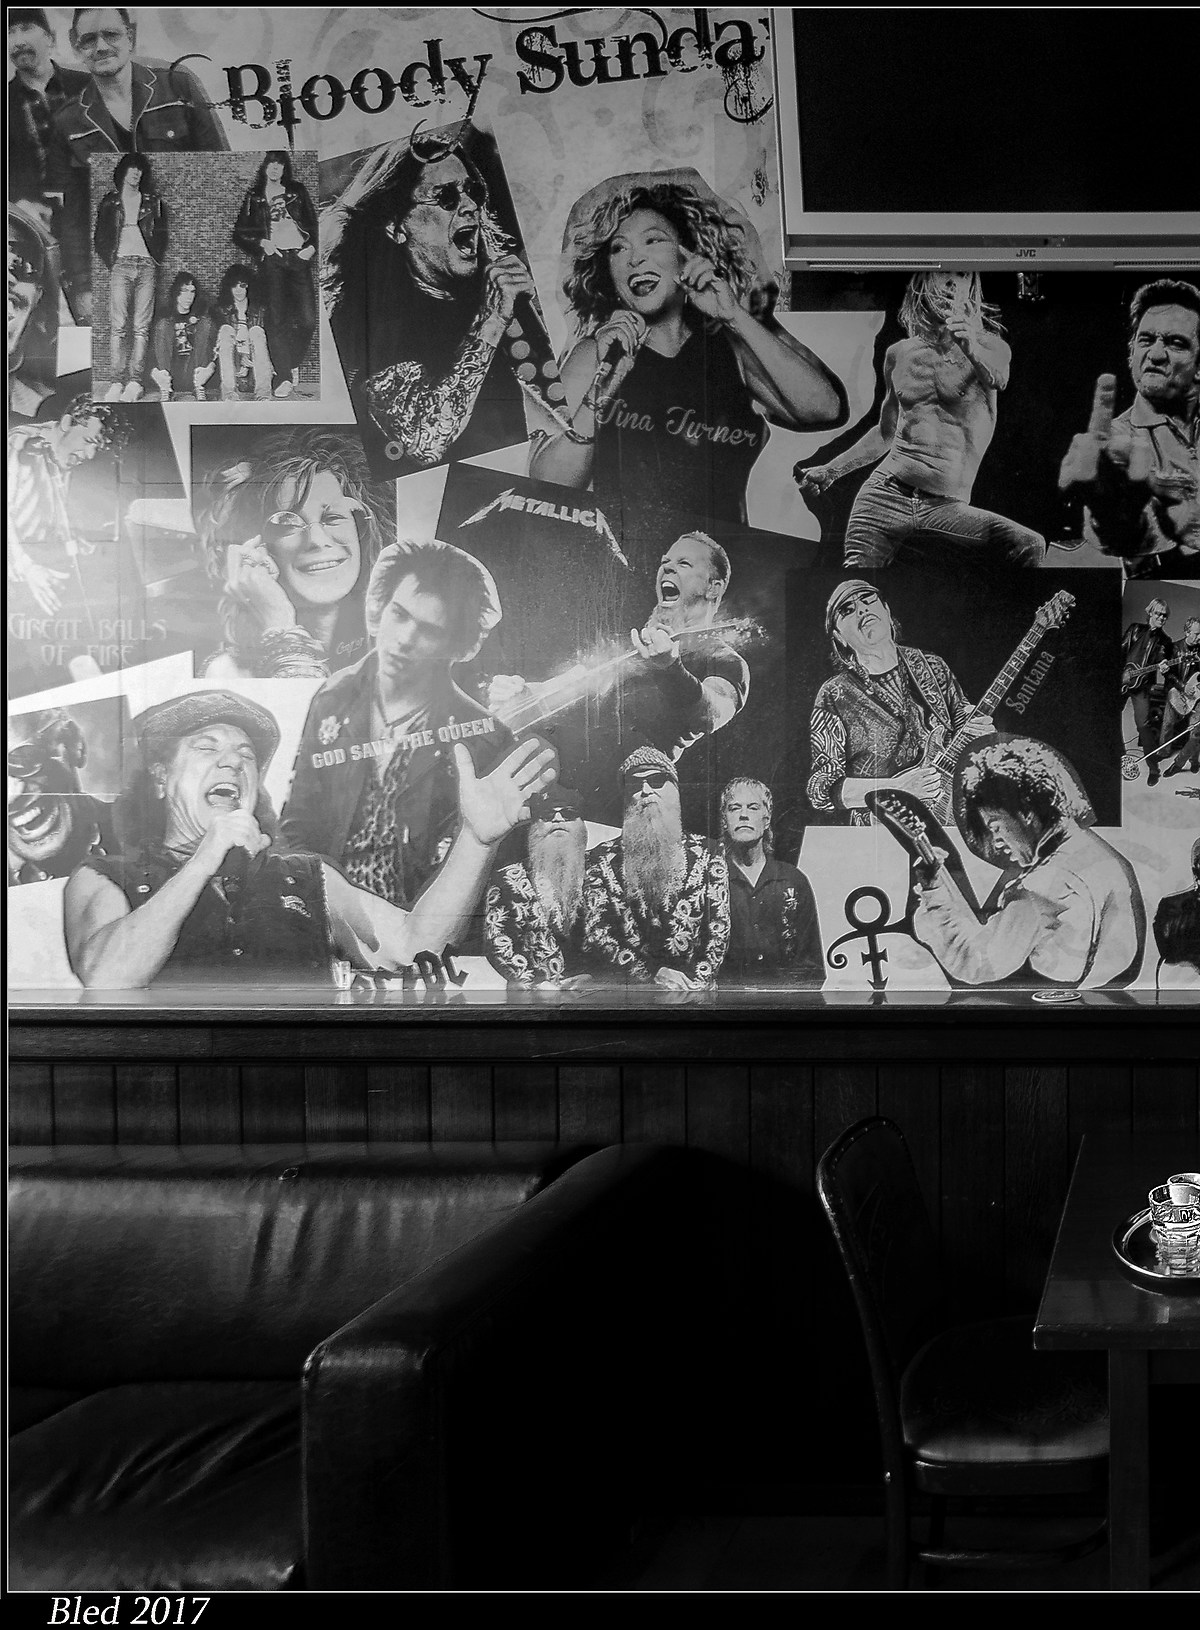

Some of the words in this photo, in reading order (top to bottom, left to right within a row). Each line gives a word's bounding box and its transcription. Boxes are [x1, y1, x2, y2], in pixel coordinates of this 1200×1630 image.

[222, 38, 493, 160] Bloody
[1016, 249, 1036, 257] JVC
[596, 396, 655, 432] Tina
[666, 406, 759, 447] Turner
[457, 487, 629, 567] METALLICA
[8, 613, 83, 641] GREAT
[98, 618, 168, 641] BALLS
[40, 644, 69, 666] OF
[1005, 651, 1056, 715] Santana
[312, 748, 346, 769] GOD
[401, 729, 434, 750] THE
[438, 716, 495, 743] QUEEN
